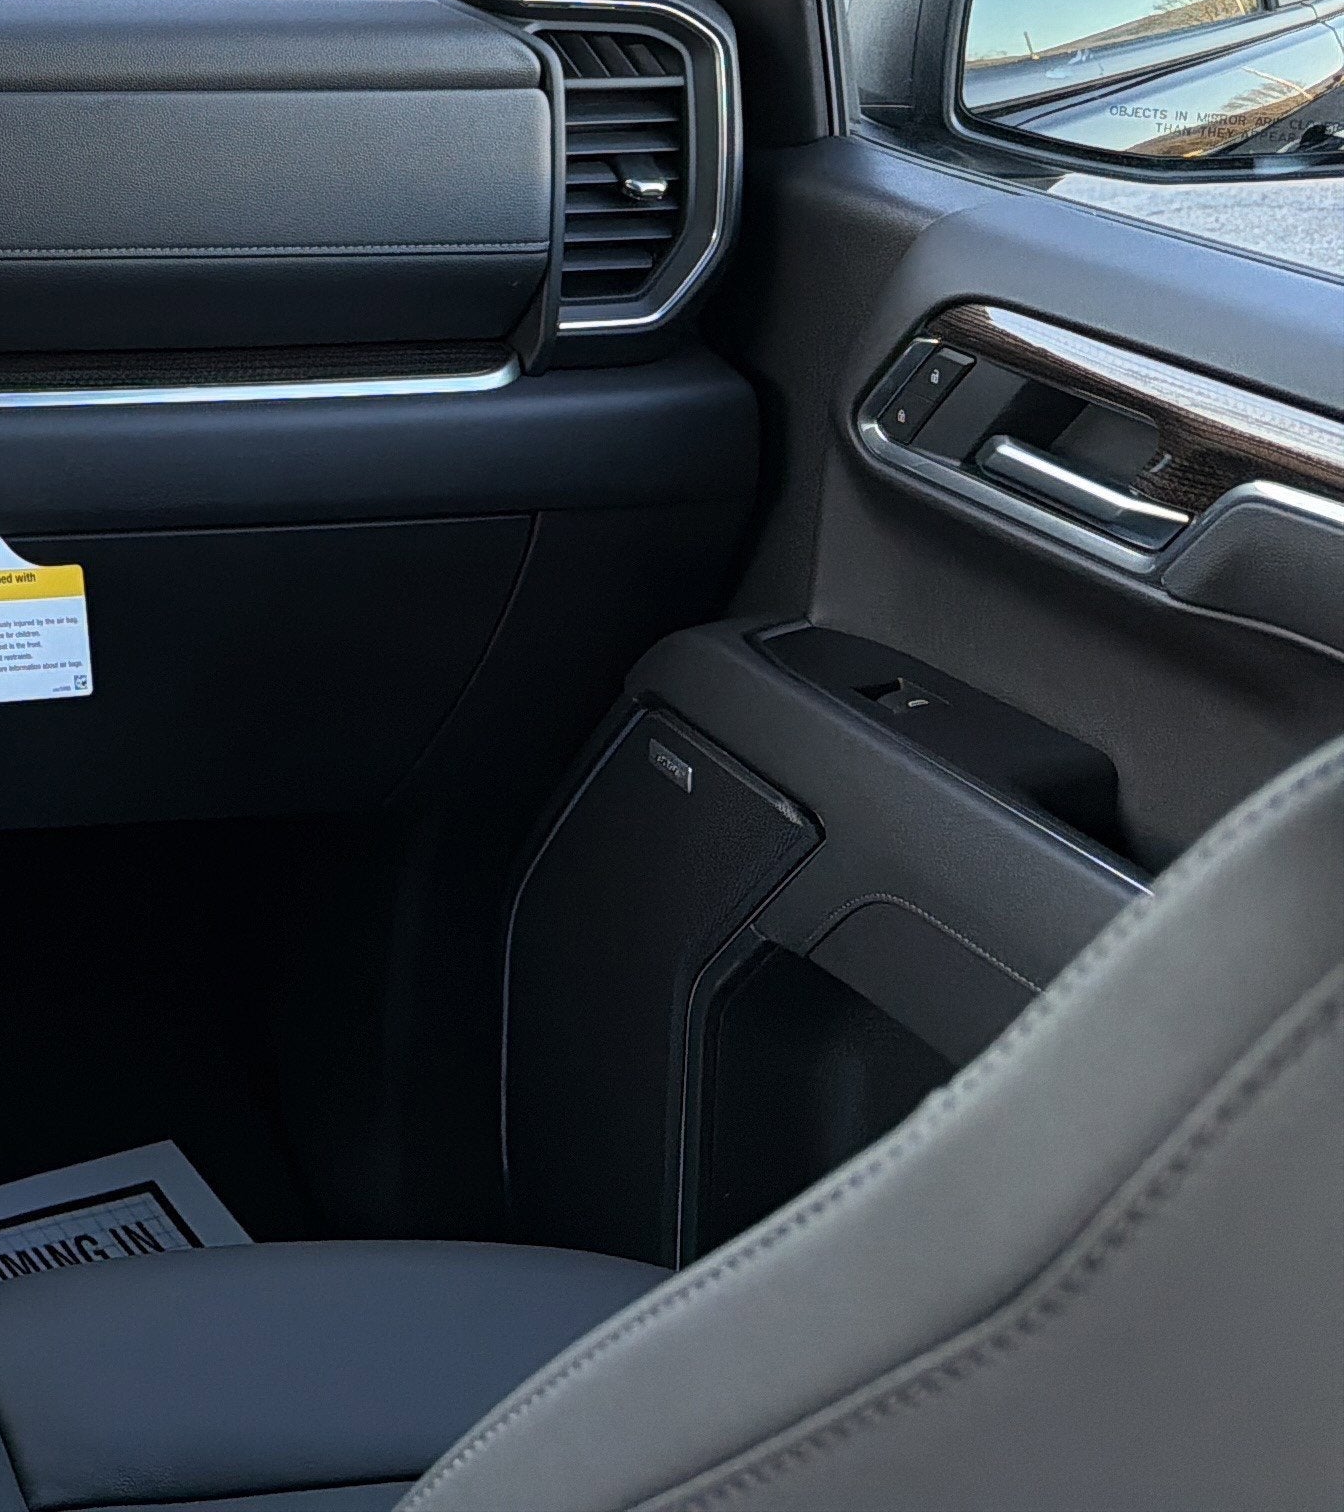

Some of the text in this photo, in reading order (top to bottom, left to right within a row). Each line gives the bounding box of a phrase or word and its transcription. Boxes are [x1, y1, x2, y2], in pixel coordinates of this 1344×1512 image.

[1109, 105, 1168, 120] OBJECTS
[1175, 110, 1189, 121] IN
[1196, 112, 1247, 127] MIRROR
[1155, 122, 1192, 136] THAN
[1199, 125, 1235, 138] THEY
[15, 572, 36, 583] with
[109, 1221, 165, 1256] IN
